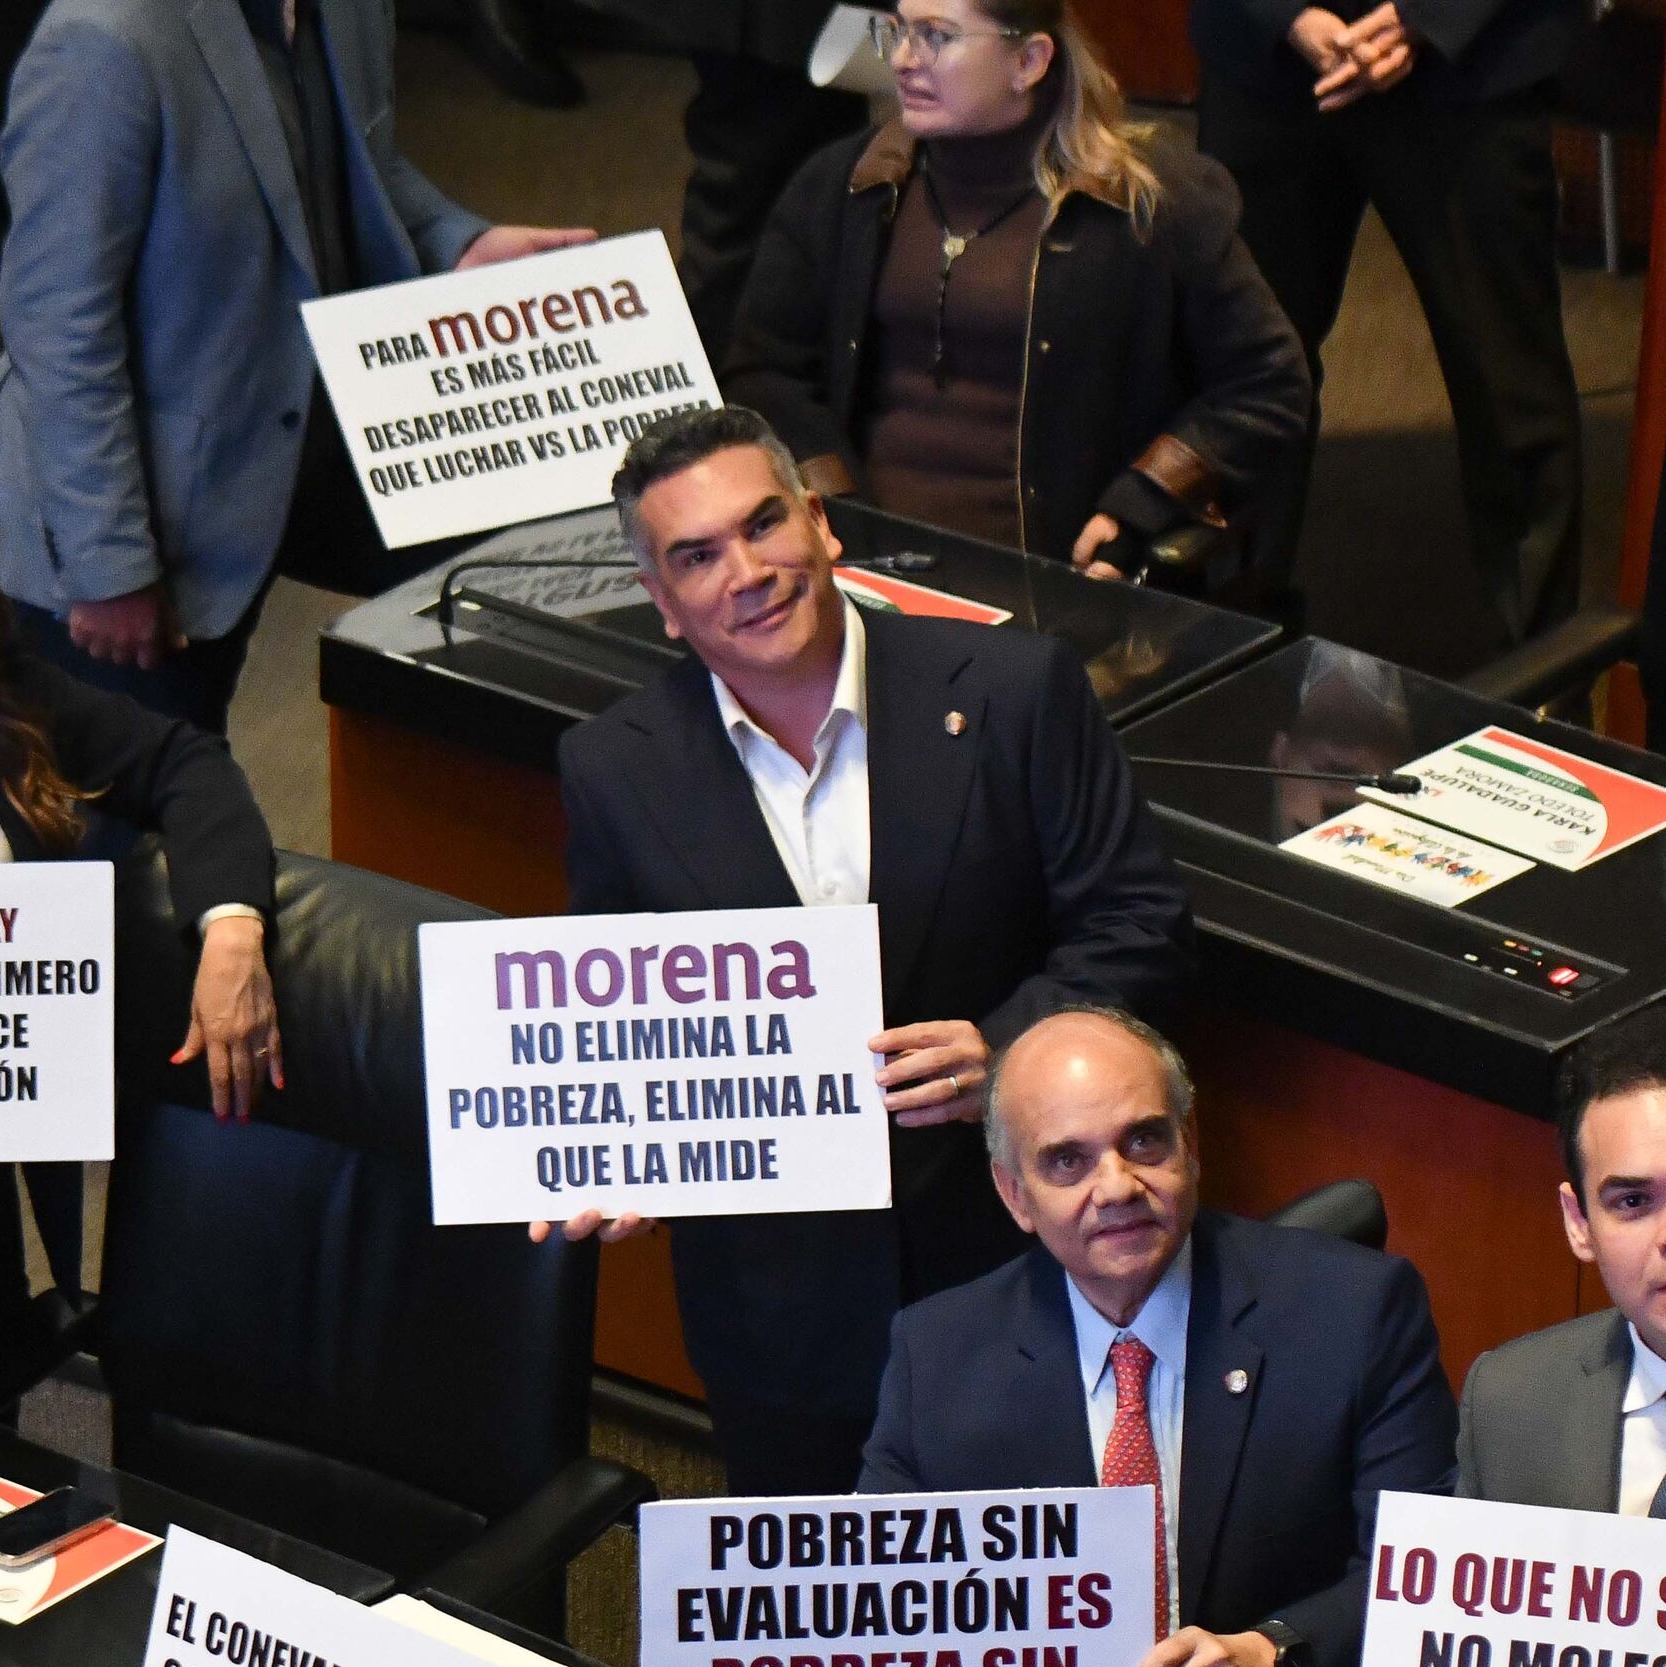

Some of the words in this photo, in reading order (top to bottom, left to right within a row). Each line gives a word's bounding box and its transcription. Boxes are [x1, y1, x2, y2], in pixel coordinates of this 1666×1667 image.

[359, 334, 428, 369] PARA
[428, 280, 646, 357] morena
[431, 367, 463, 396] ES
[467, 354, 525, 389] MÁS
[528, 340, 597, 376] FÁCIL
[364, 394, 542, 452] DESAPARECER
[547, 387, 576, 415] AL
[581, 363, 691, 407] CONEVAL
[370, 462, 421, 496] QUE
[423, 440, 526, 483] LUCHAR
[528, 432, 564, 460] VS
[568, 425, 600, 452] LA
[496, 941, 816, 1009] morena
[511, 1023, 563, 1064] NO
[576, 1016, 735, 1062] ELIMINA
[746, 1014, 791, 1055] LA
[449, 1083, 634, 1128] POBREZA,
[646, 1076, 806, 1121] ELIMINA
[816, 1073, 861, 1115] AL
[537, 1145, 611, 1192] QUE
[623, 1144, 668, 1184] LA
[679, 1139, 778, 1182] MIDE
[711, 1507, 968, 1570] POBREZA
[982, 1503, 1078, 1561] SIN
[167, 1593, 197, 1645] EL
[678, 1568, 1029, 1642] EVALUACIÓN
[1048, 1573, 1112, 1629] ES
[1376, 1545, 1436, 1604] LO
[1453, 1553, 1555, 1617] QUE
[1569, 1566, 1642, 1627] NO
